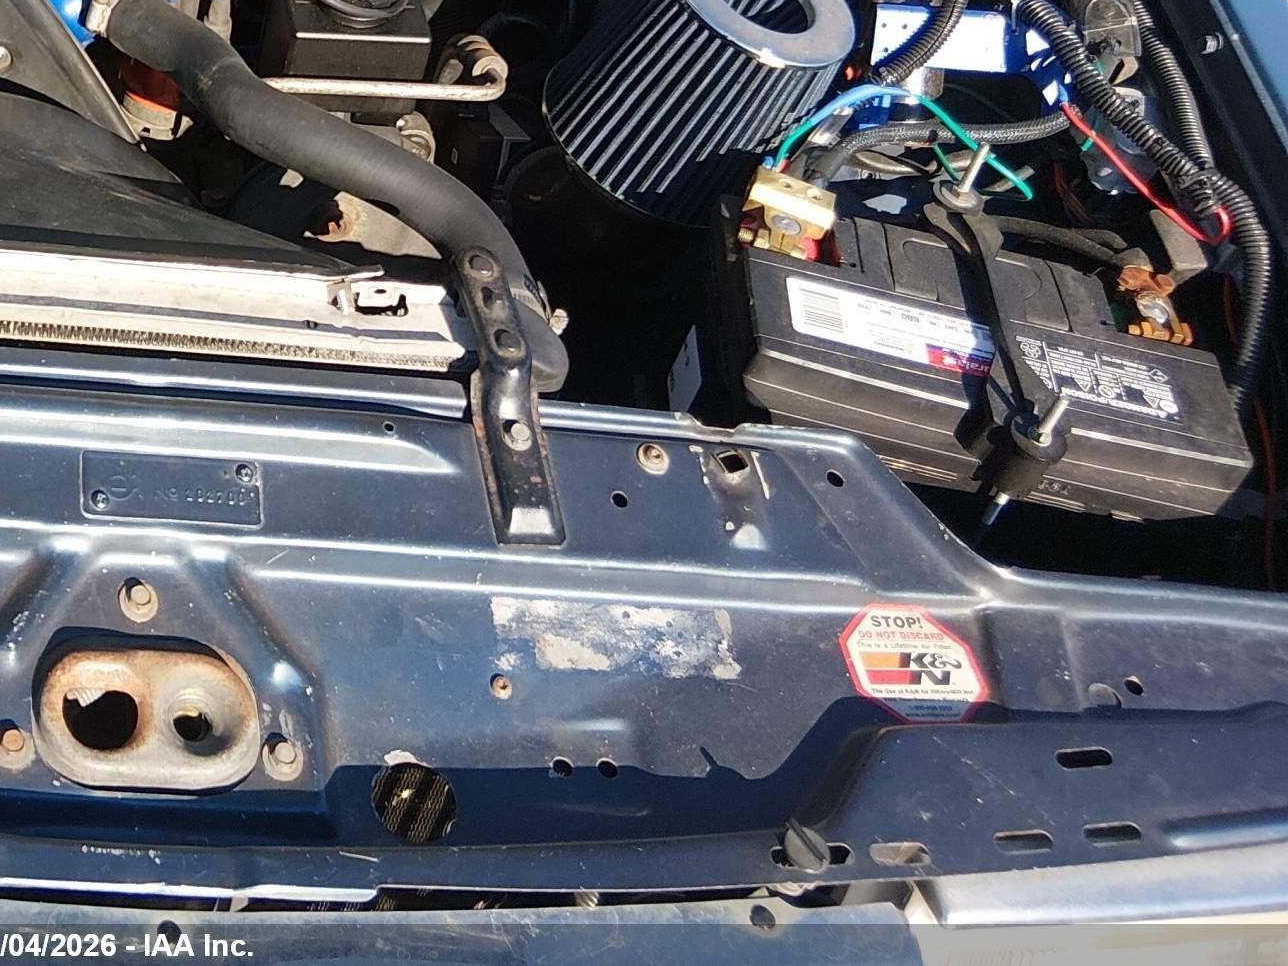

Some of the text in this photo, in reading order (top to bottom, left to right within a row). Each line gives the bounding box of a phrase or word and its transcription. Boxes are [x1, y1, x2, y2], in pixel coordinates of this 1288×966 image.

[870, 615, 923, 630] STOP!
[858, 630, 944, 641] DO NOT DISCARD
